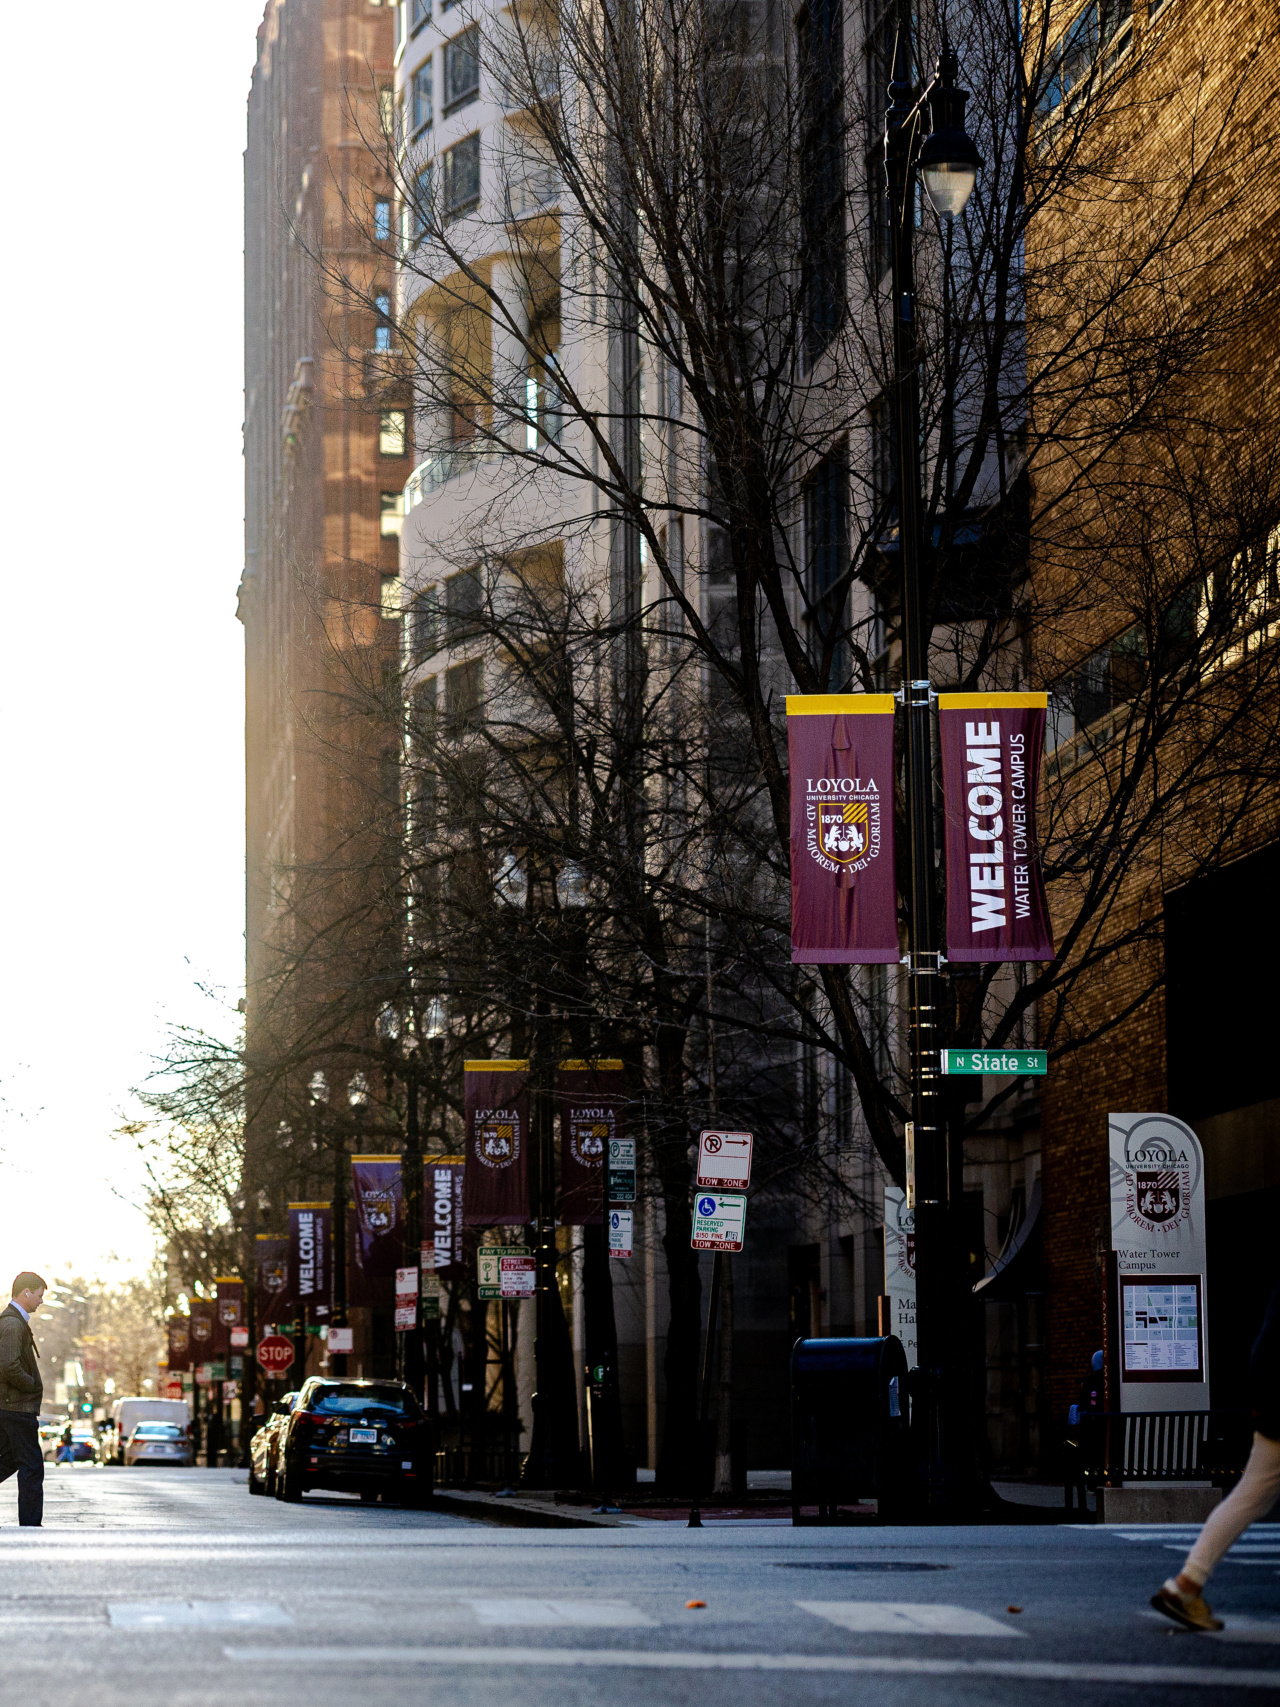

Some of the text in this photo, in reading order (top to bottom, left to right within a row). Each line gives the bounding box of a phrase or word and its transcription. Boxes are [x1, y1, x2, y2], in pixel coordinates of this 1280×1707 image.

[806, 778, 879, 792] LOYOLA
[821, 814, 842, 824] 1870
[1010, 733, 1031, 919] WATER TOWER CAMPUS
[965, 721, 1007, 933] WELCOME
[806, 828, 840, 874] MAJOREM
[848, 858, 868, 874] DEI
[870, 802, 880, 858] GLORIAM
[956, 1054, 1038, 1070] N State St
[1126, 1150, 1188, 1162] LOYOLA
[1126, 1193, 1155, 1232] MAJOREM
[1162, 1220, 1179, 1233] DEI
[1180, 1171, 1190, 1218] GLORIAM
[434, 1169, 452, 1268] WELCOME
[898, 1217, 915, 1226] LO
[298, 1212, 314, 1295] WELCOME
[1118, 1250, 1180, 1258] Water Tower
[898, 1251, 916, 1280] MAJORE
[1118, 1261, 1156, 1270] Campus
[898, 1299, 916, 1309] Ma
[260, 1347, 292, 1360] STOP
